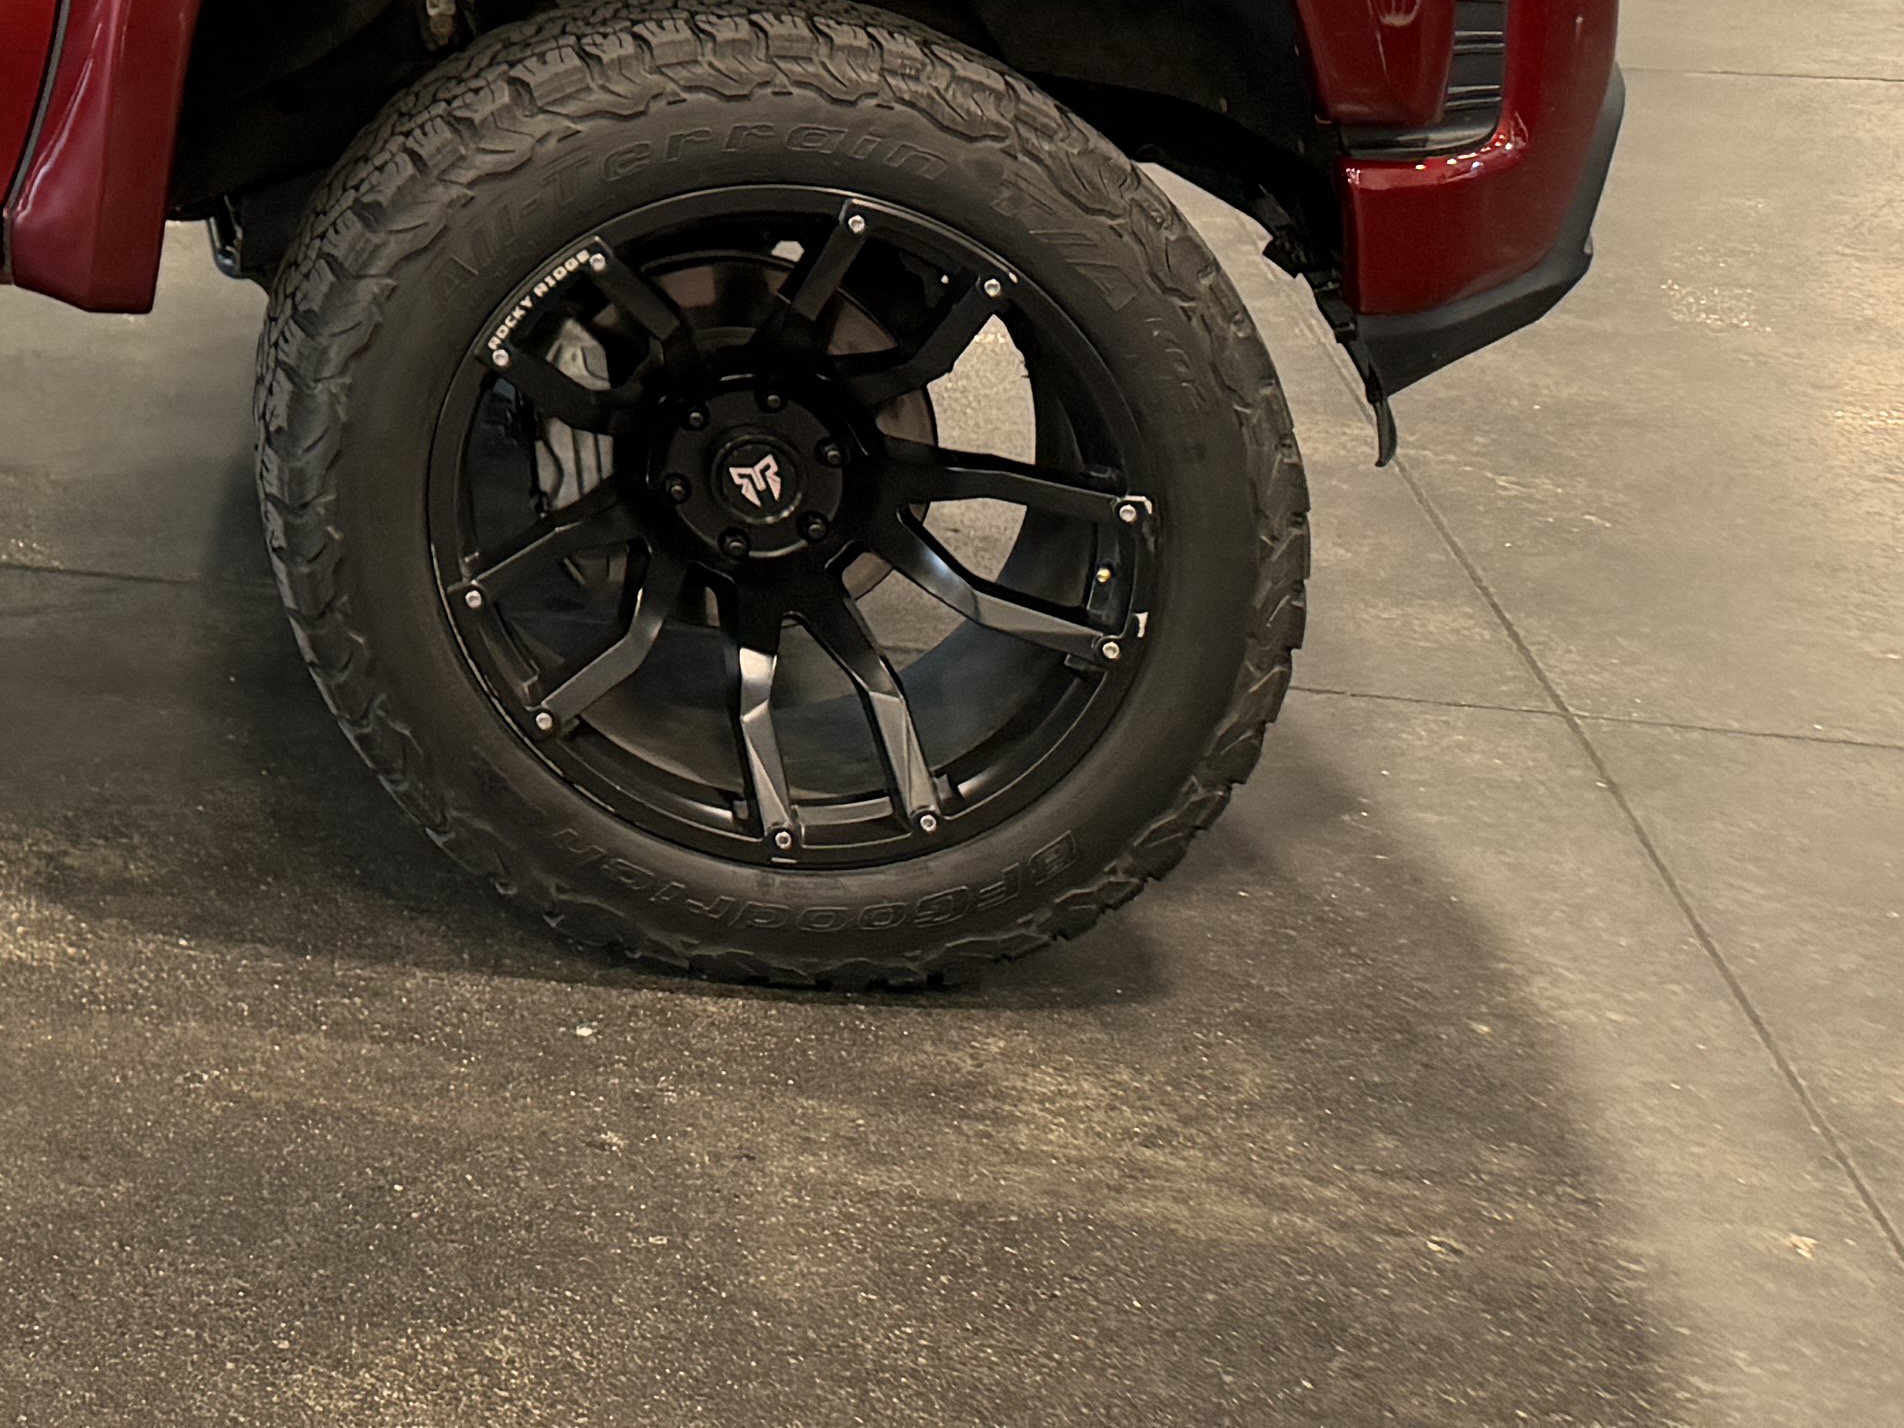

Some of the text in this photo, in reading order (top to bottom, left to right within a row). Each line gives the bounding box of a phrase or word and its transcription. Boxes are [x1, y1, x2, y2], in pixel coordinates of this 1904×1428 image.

[434, 121, 951, 294] All-Terrain
[487, 248, 590, 350] ROCKY RIDGE
